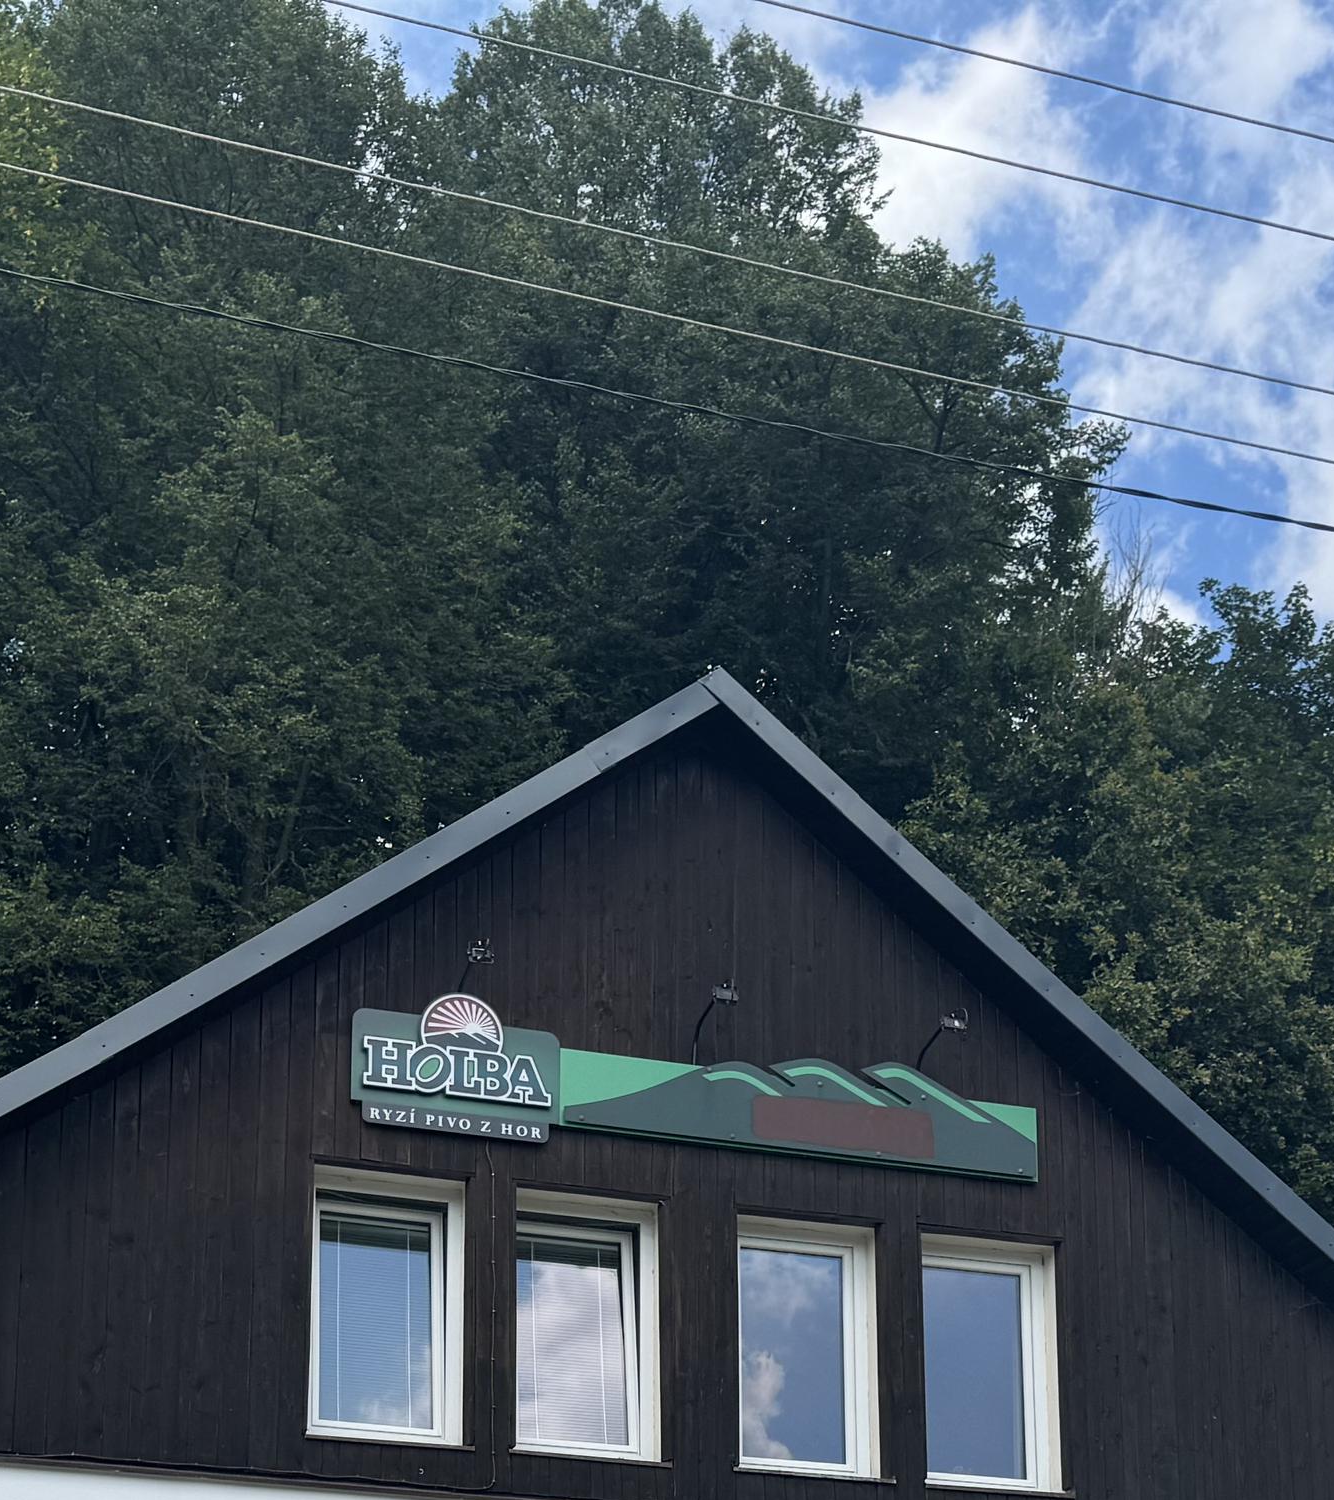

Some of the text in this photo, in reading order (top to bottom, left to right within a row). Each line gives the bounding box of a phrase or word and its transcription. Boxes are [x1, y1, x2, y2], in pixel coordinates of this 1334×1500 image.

[363, 1035, 551, 1107] HOLBA
[369, 1107, 542, 1139] RYZÍ PIVO Z HOR
